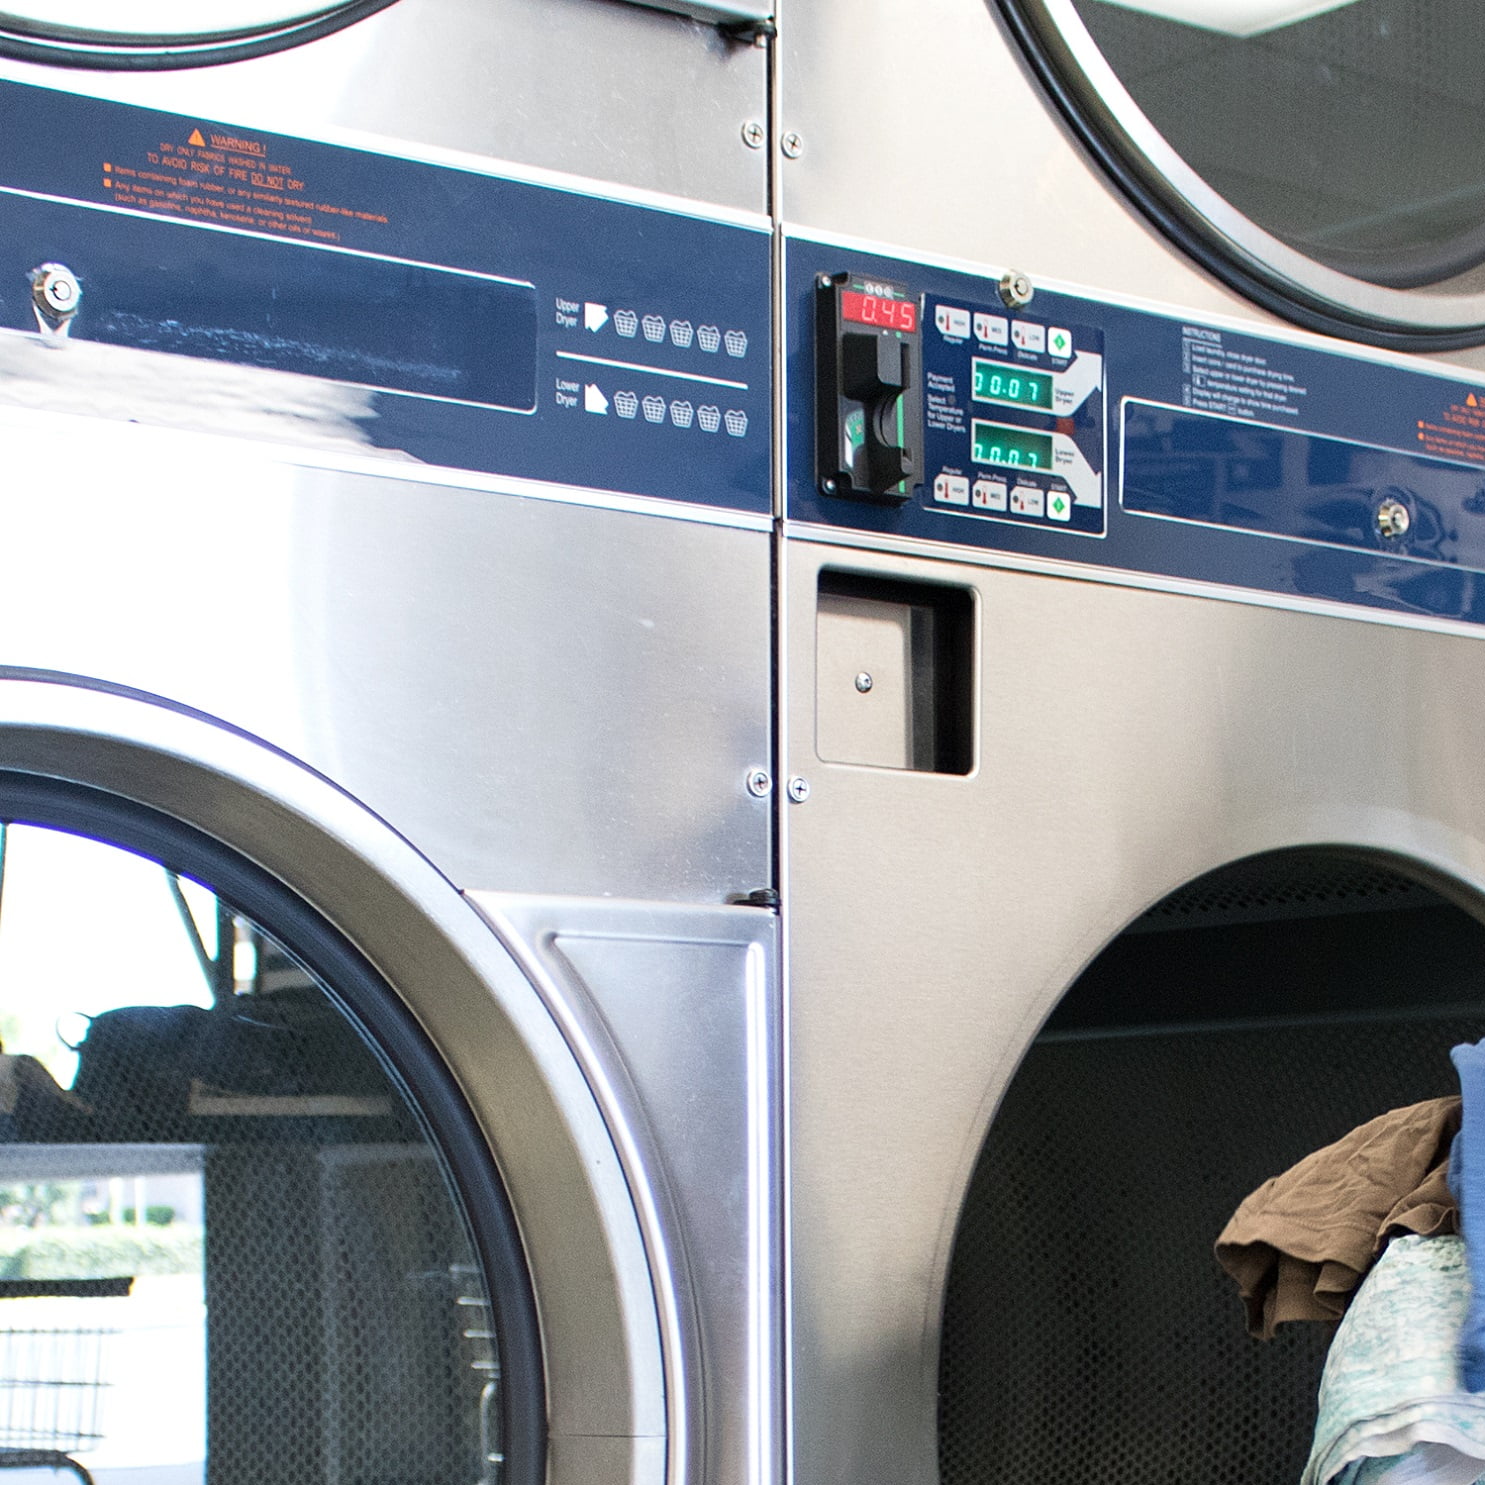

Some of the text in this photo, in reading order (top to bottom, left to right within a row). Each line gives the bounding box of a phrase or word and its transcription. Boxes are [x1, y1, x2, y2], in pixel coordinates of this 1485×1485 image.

[210, 134, 260, 155] WARNING
[147, 152, 159, 164] TO
[162, 155, 187, 170] AVOID
[190, 161, 210, 174] RISK
[214, 165, 225, 176] OF
[229, 168, 248, 181] FIRE
[251, 172, 263, 185] DO
[267, 175, 284, 189] NOT
[556, 297, 579, 313] Upper
[862, 296, 913, 328] 0.45
[556, 311, 577, 328] Dryer
[556, 377, 579, 392] Lower
[556, 391, 578, 408] Dryer
